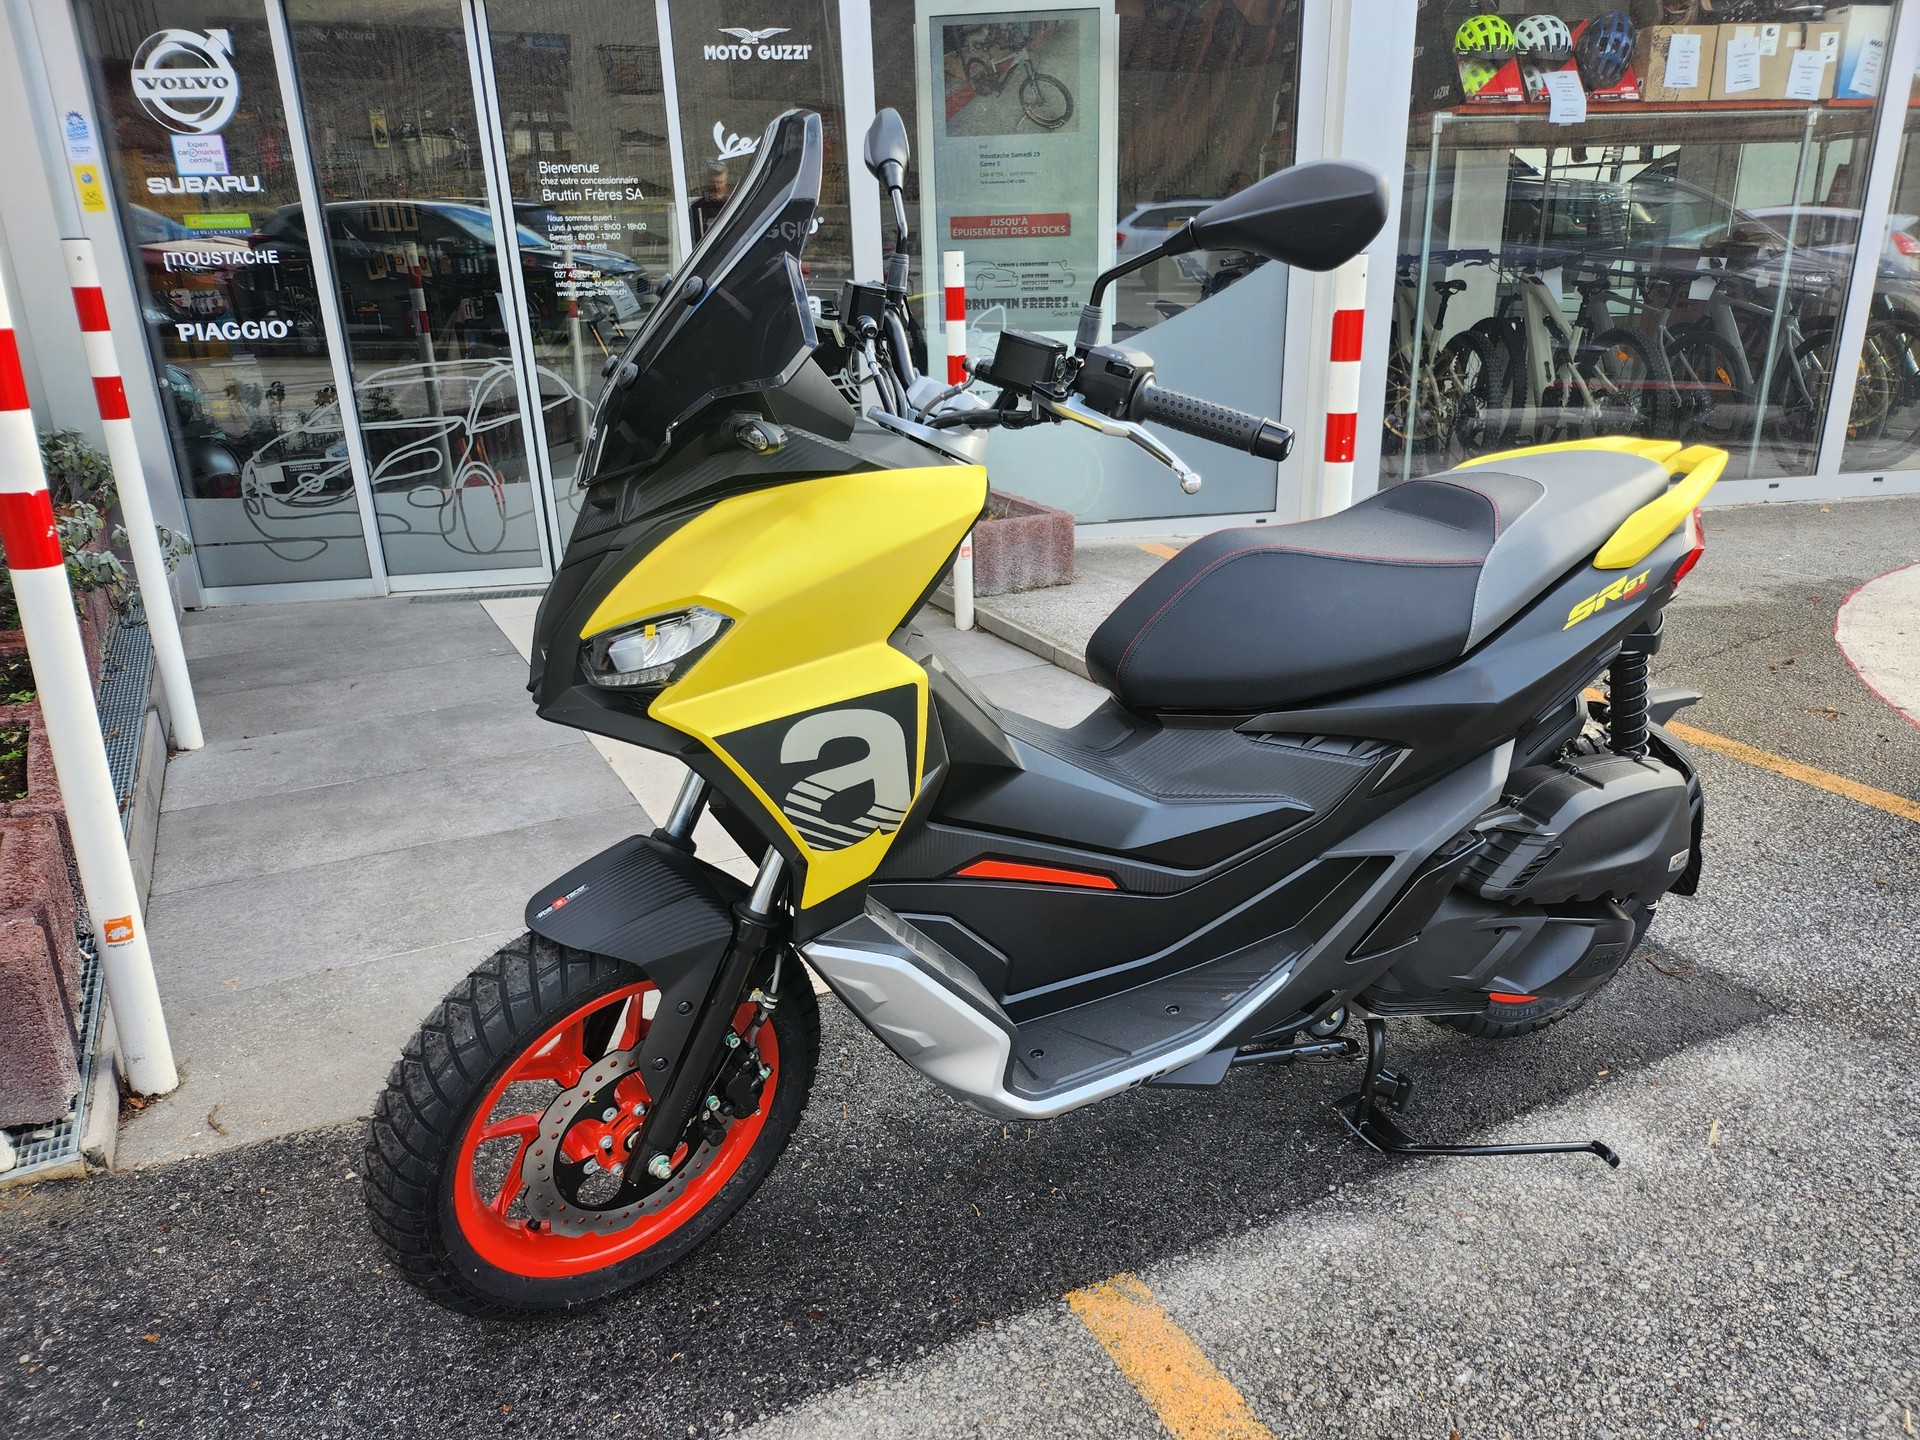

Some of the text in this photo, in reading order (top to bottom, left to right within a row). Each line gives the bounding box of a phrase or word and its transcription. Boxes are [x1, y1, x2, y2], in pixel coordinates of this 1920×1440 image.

[704, 44, 809, 61] MOTO GUZZI
[136, 76, 229, 91] VOLVO
[1433, 85, 1450, 100] LAZER
[539, 161, 600, 174] Bienvenue
[146, 175, 261, 194] SUBARU
[560, 177, 579, 185] votre
[580, 176, 639, 185] concessionnaire
[543, 188, 644, 202] Bruttin Frères SA
[989, 216, 1028, 227] JUSQU'À
[952, 225, 1067, 237] ÉPUISEMENT DES STOCKS
[162, 250, 280, 272] MOUSTACHE
[553, 262, 577, 270] Contact
[554, 271, 566, 279] 027
[556, 288, 628, 298] www.garage-bruttin.ch
[965, 298, 1020, 311] BRUTTIN
[1022, 296, 1069, 309] FRERES
[175, 320, 289, 342] PIAGGIO
[1562, 575, 1628, 631] SR
